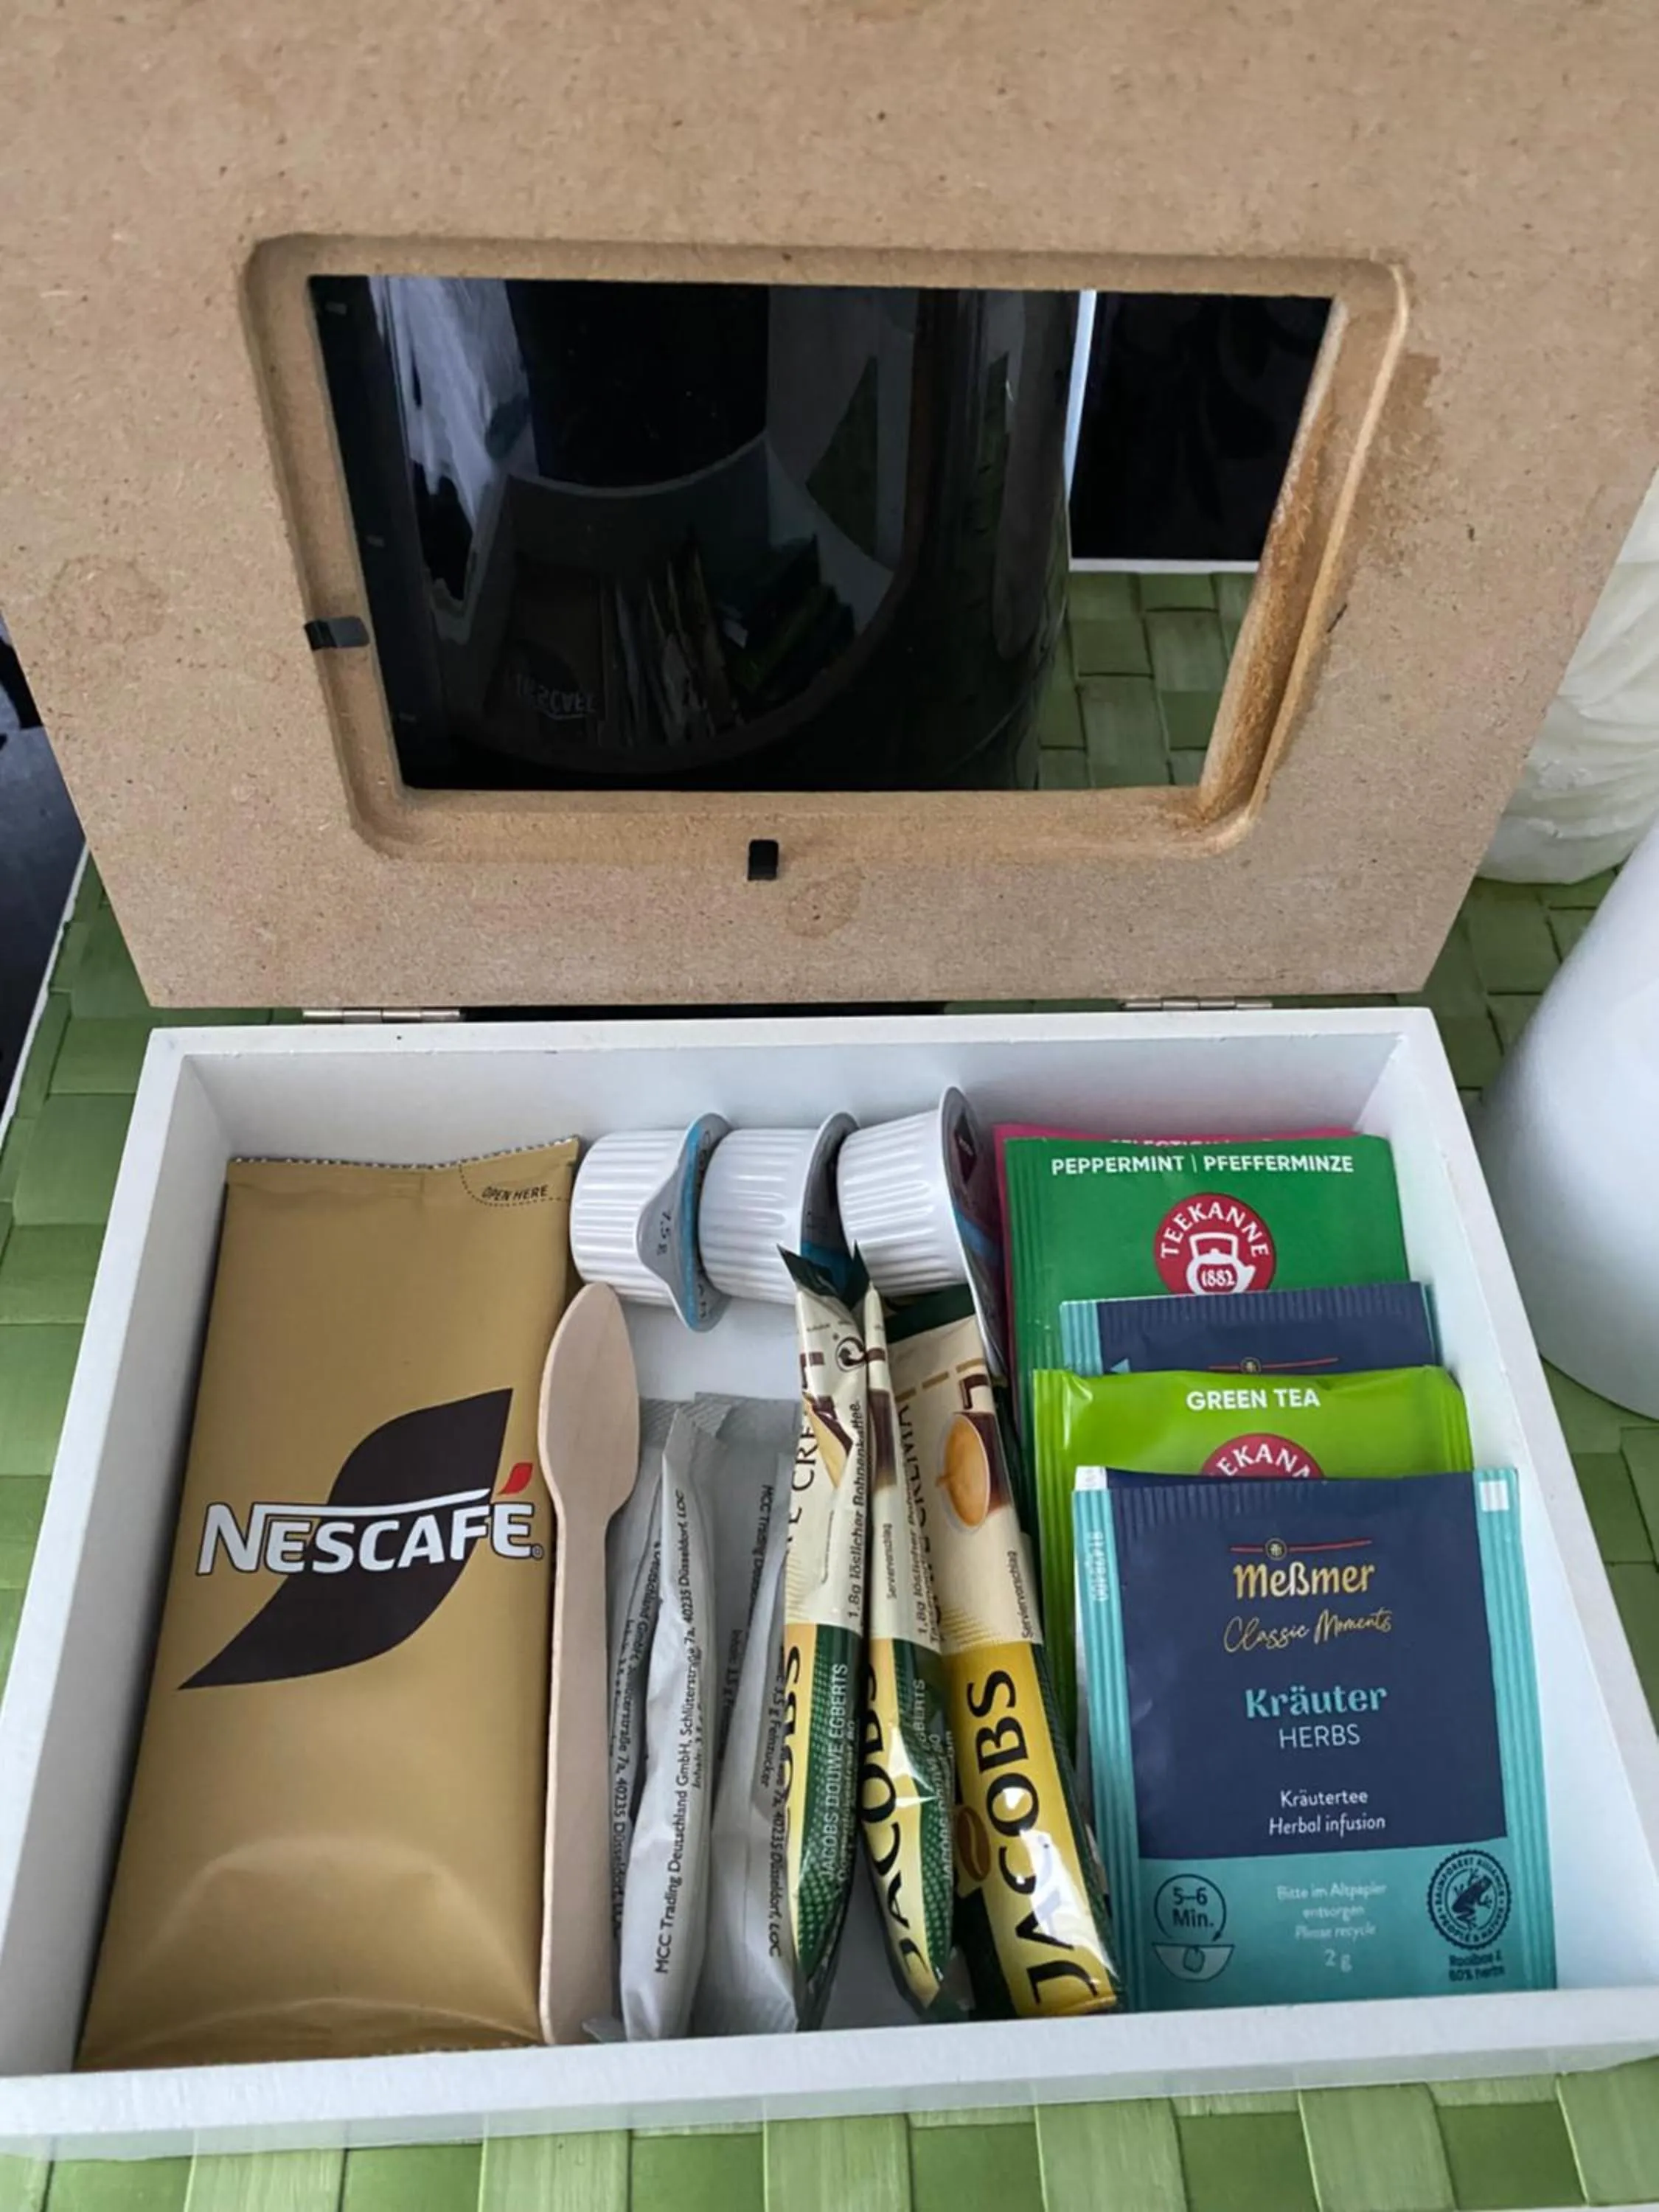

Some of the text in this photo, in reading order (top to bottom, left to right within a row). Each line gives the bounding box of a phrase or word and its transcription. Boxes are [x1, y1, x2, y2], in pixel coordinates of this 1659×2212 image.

[1051, 1155, 1354, 1175] PEPPERMINT PFEFFERMINZE
[481, 1184, 549, 1201] OPEN HERE
[1161, 1201, 1269, 1259] TEEKANNE
[1201, 1268, 1236, 1287] 1882
[1186, 1388, 1321, 1411] GREEN TEA
[1217, 1443, 1311, 1478] EKANN
[849, 1510, 864, 1579] löslicher
[882, 1523, 898, 1599] Serviervorschlag
[1006, 1550, 1034, 1638] Serviervorschlag
[1233, 1561, 1375, 1599] Meßmer
[680, 1590, 694, 1623] 40235
[1223, 1607, 1393, 1652] Classic Moments
[1245, 1684, 1388, 1719] Kräuter
[760, 1719, 781, 1788] Feinzucker
[1279, 1723, 1360, 1750] HERBS
[676, 1739, 693, 1786] GmbH,
[817, 1663, 848, 1881] JACOBS DOUWE EGBERTS
[612, 1777, 628, 1818] 40235
[1280, 1788, 1368, 1808] Kräutertee
[667, 1790, 688, 1873] Deutschland
[770, 1812, 786, 1849] 40235
[967, 1669, 1099, 2005] JACOBS
[1269, 1812, 1385, 1838] Herbal infusion
[659, 1876, 683, 1930] Trading
[1277, 1882, 1387, 1901] Bitte im Altpapier
[1172, 1907, 1214, 1928] Min.
[1335, 1921, 1377, 1943] recycle
[654, 1934, 672, 1973] MCC
[768, 1923, 782, 1958] LOC
[1324, 1948, 1353, 1973] 2 g
